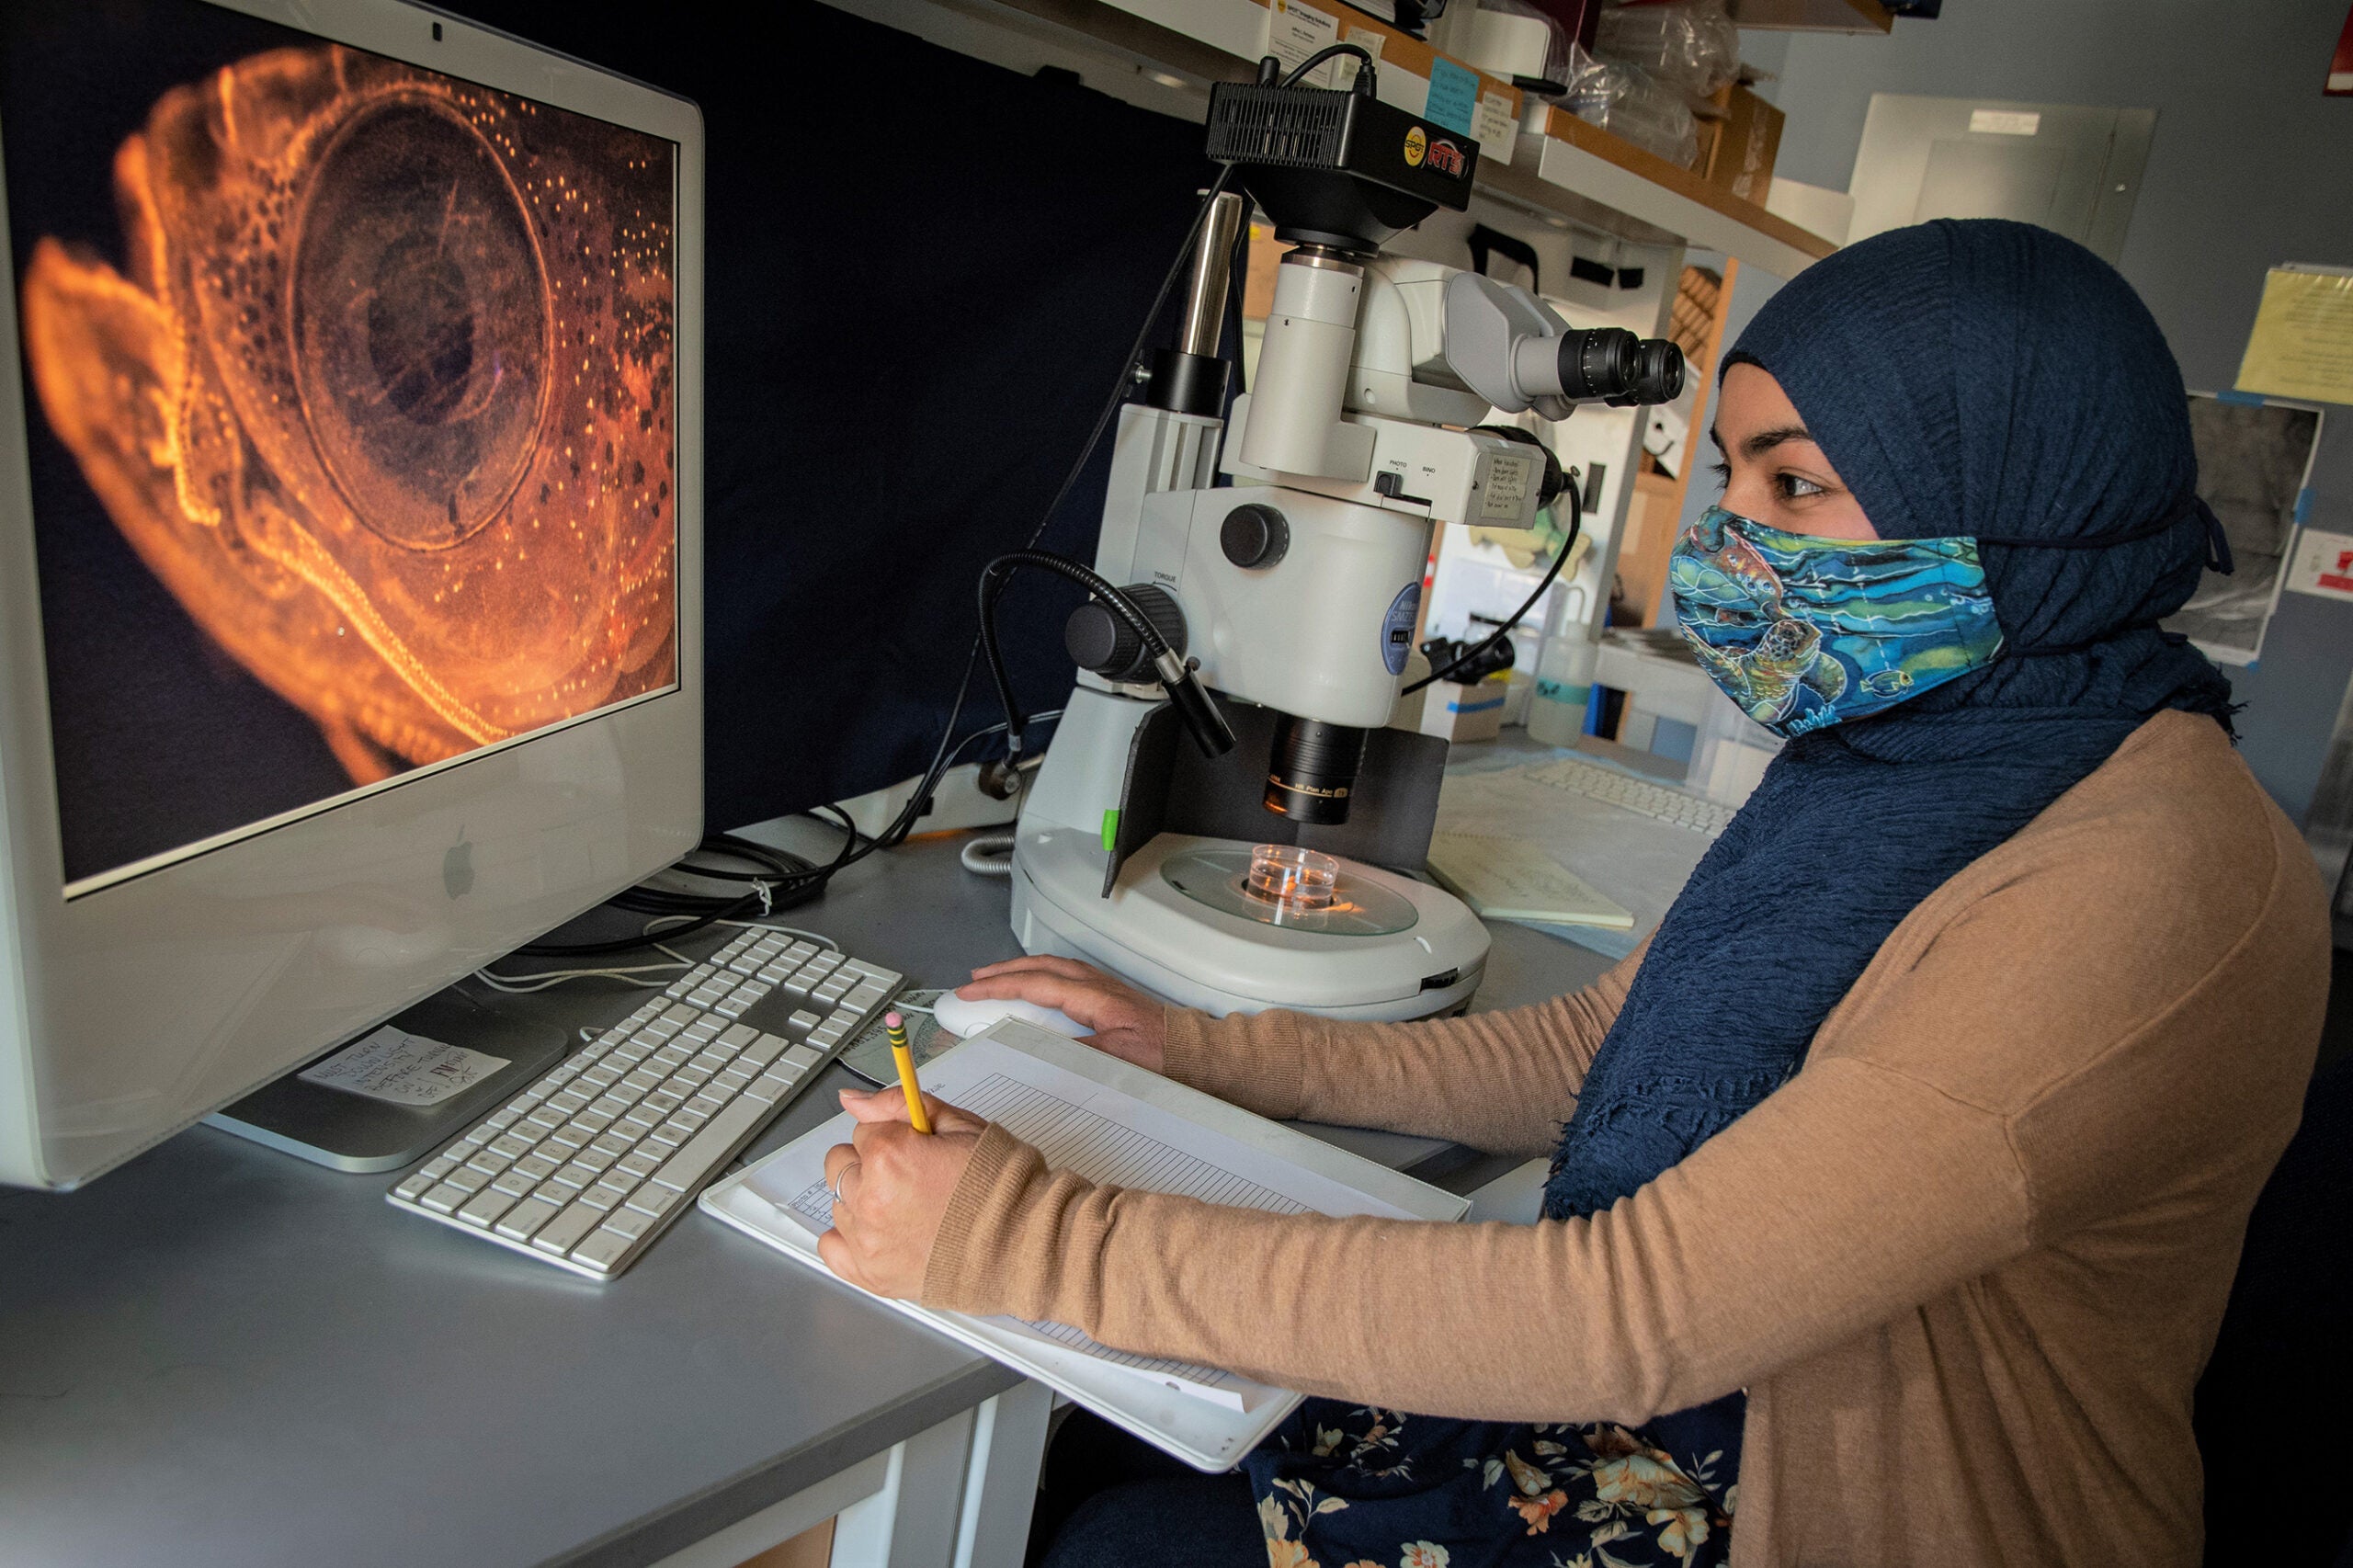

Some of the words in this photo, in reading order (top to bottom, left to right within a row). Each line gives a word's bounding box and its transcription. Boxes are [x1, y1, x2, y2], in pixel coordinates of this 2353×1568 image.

[1404, 139, 1425, 153] SPOT
[1389, 460, 1407, 468] PHOTO
[1422, 466, 1436, 474] BINO
[1154, 571, 1177, 583] TORQUE
[346, 1040, 381, 1062] TURN
